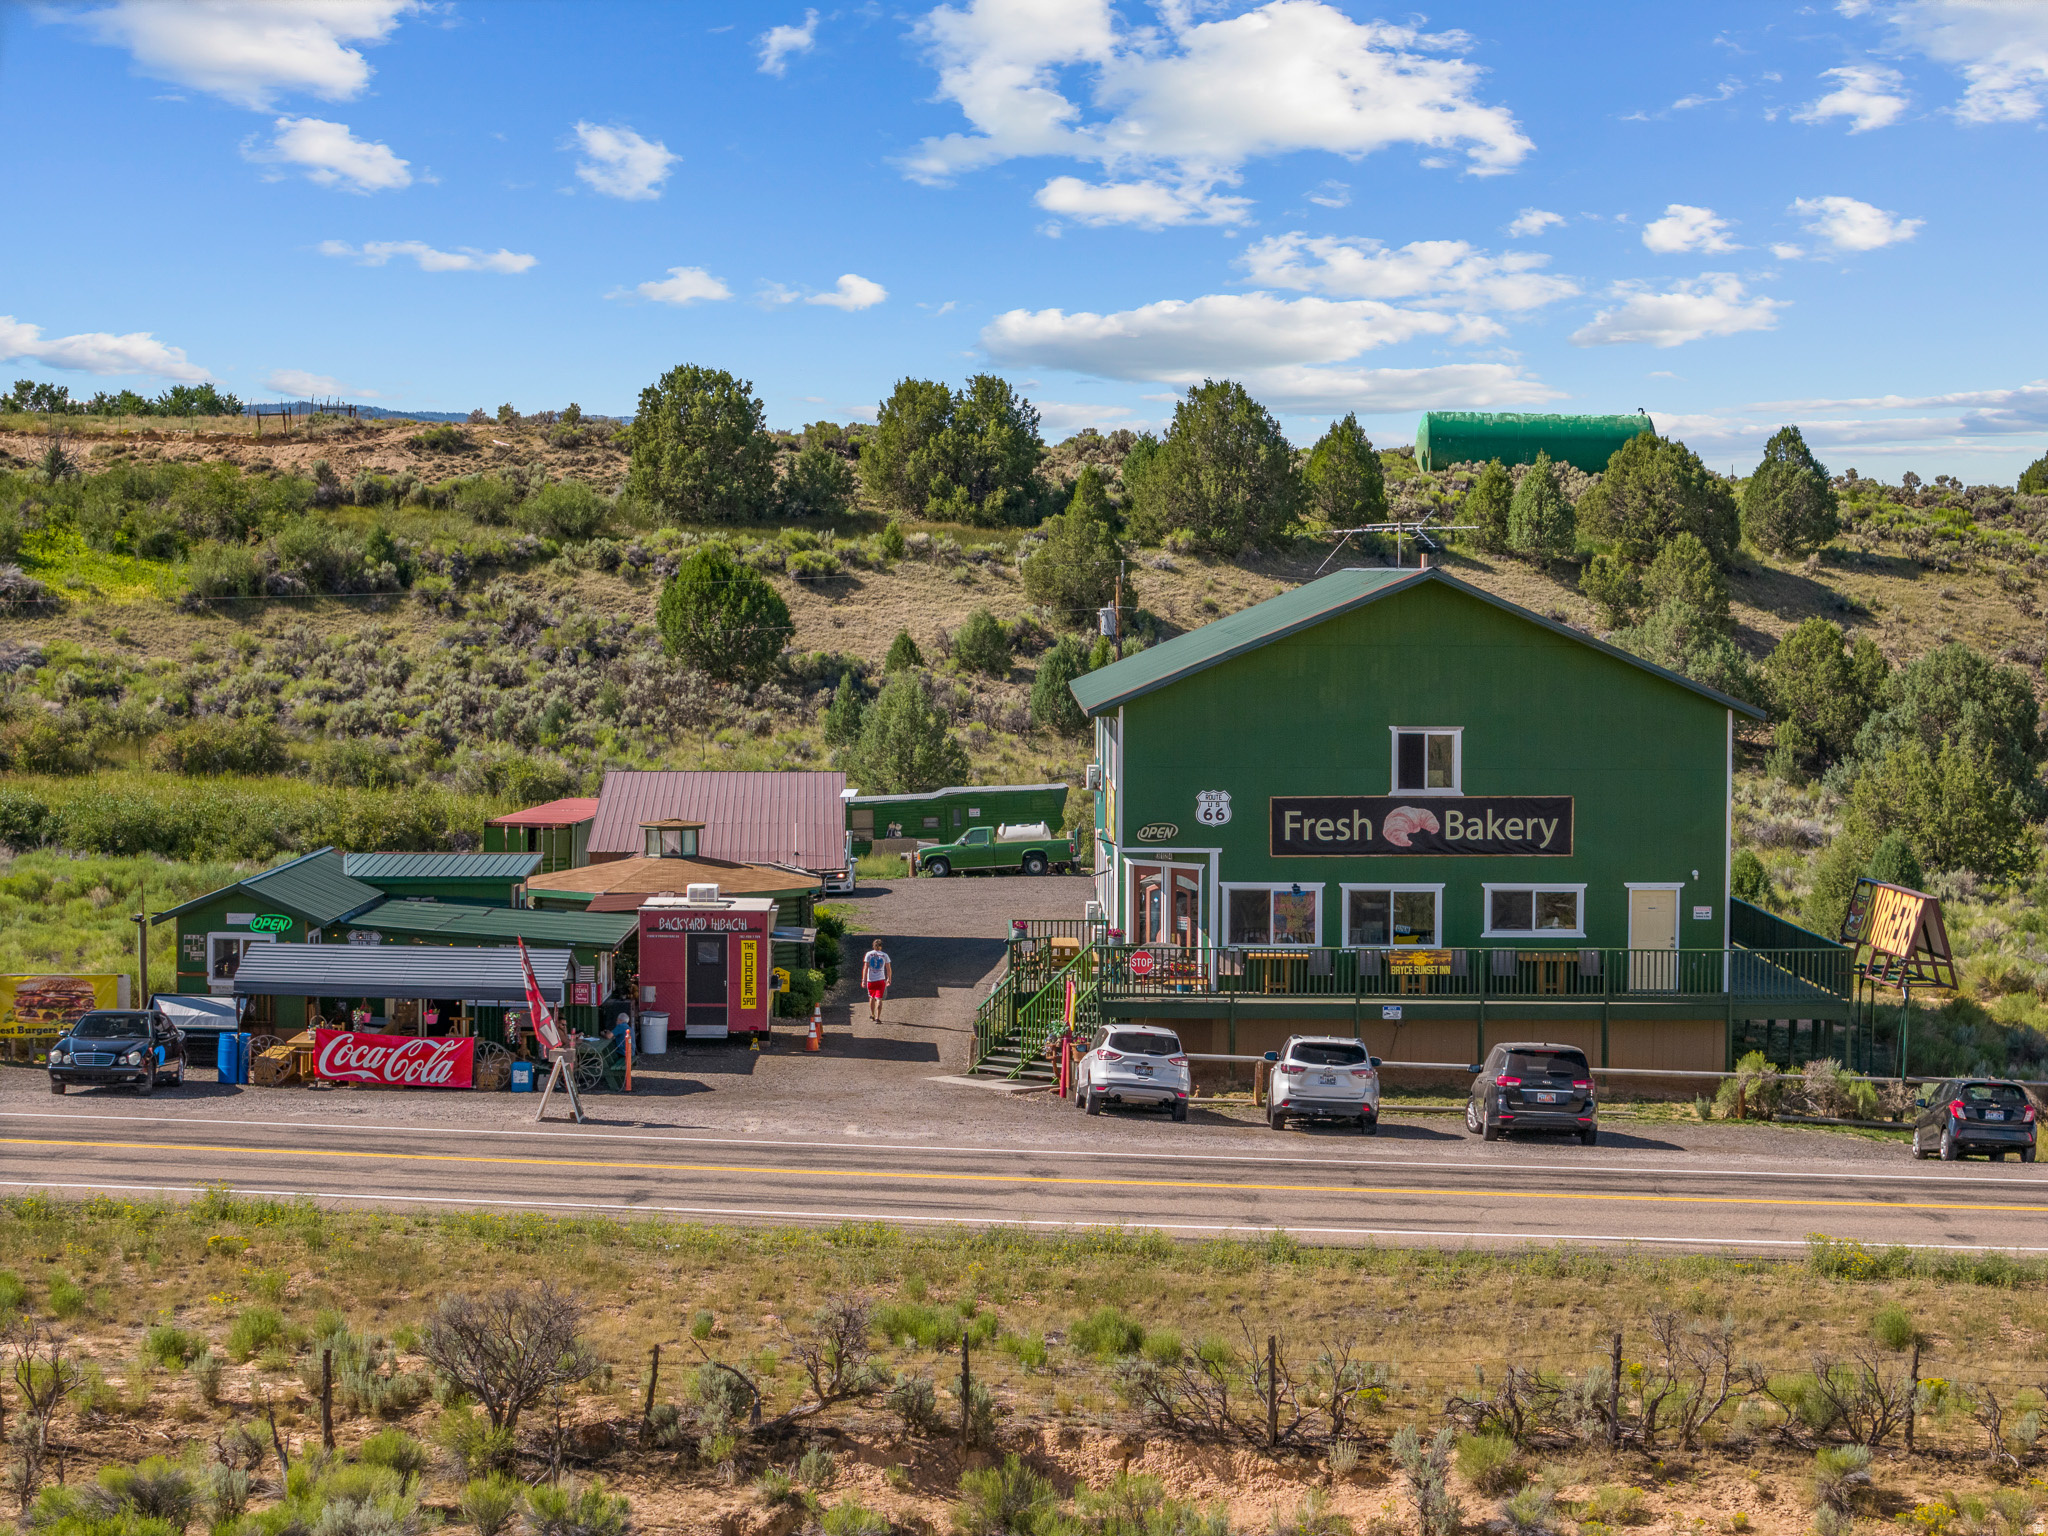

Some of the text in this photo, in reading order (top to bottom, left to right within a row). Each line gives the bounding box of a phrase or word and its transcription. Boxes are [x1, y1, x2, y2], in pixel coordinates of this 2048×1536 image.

[1203, 807, 1225, 821] 66
[1139, 826, 1174, 839] OPEN
[1284, 808, 1559, 849] Fresh Bakery
[252, 916, 288, 932] OPEN
[658, 917, 748, 931] BACKYARD HIBACHI
[1857, 885, 1924, 957] BURGERS
[743, 942, 755, 950] THE
[1131, 958, 1153, 967] STOP
[744, 952, 754, 996] BURGER
[1390, 965, 1451, 975] BRYCE SUNSET INN
[742, 997, 756, 1006] SPOT
[0, 1026, 14, 1034] est
[17, 1026, 58, 1035] Burgers
[318, 1033, 465, 1084] Coca-Cola
